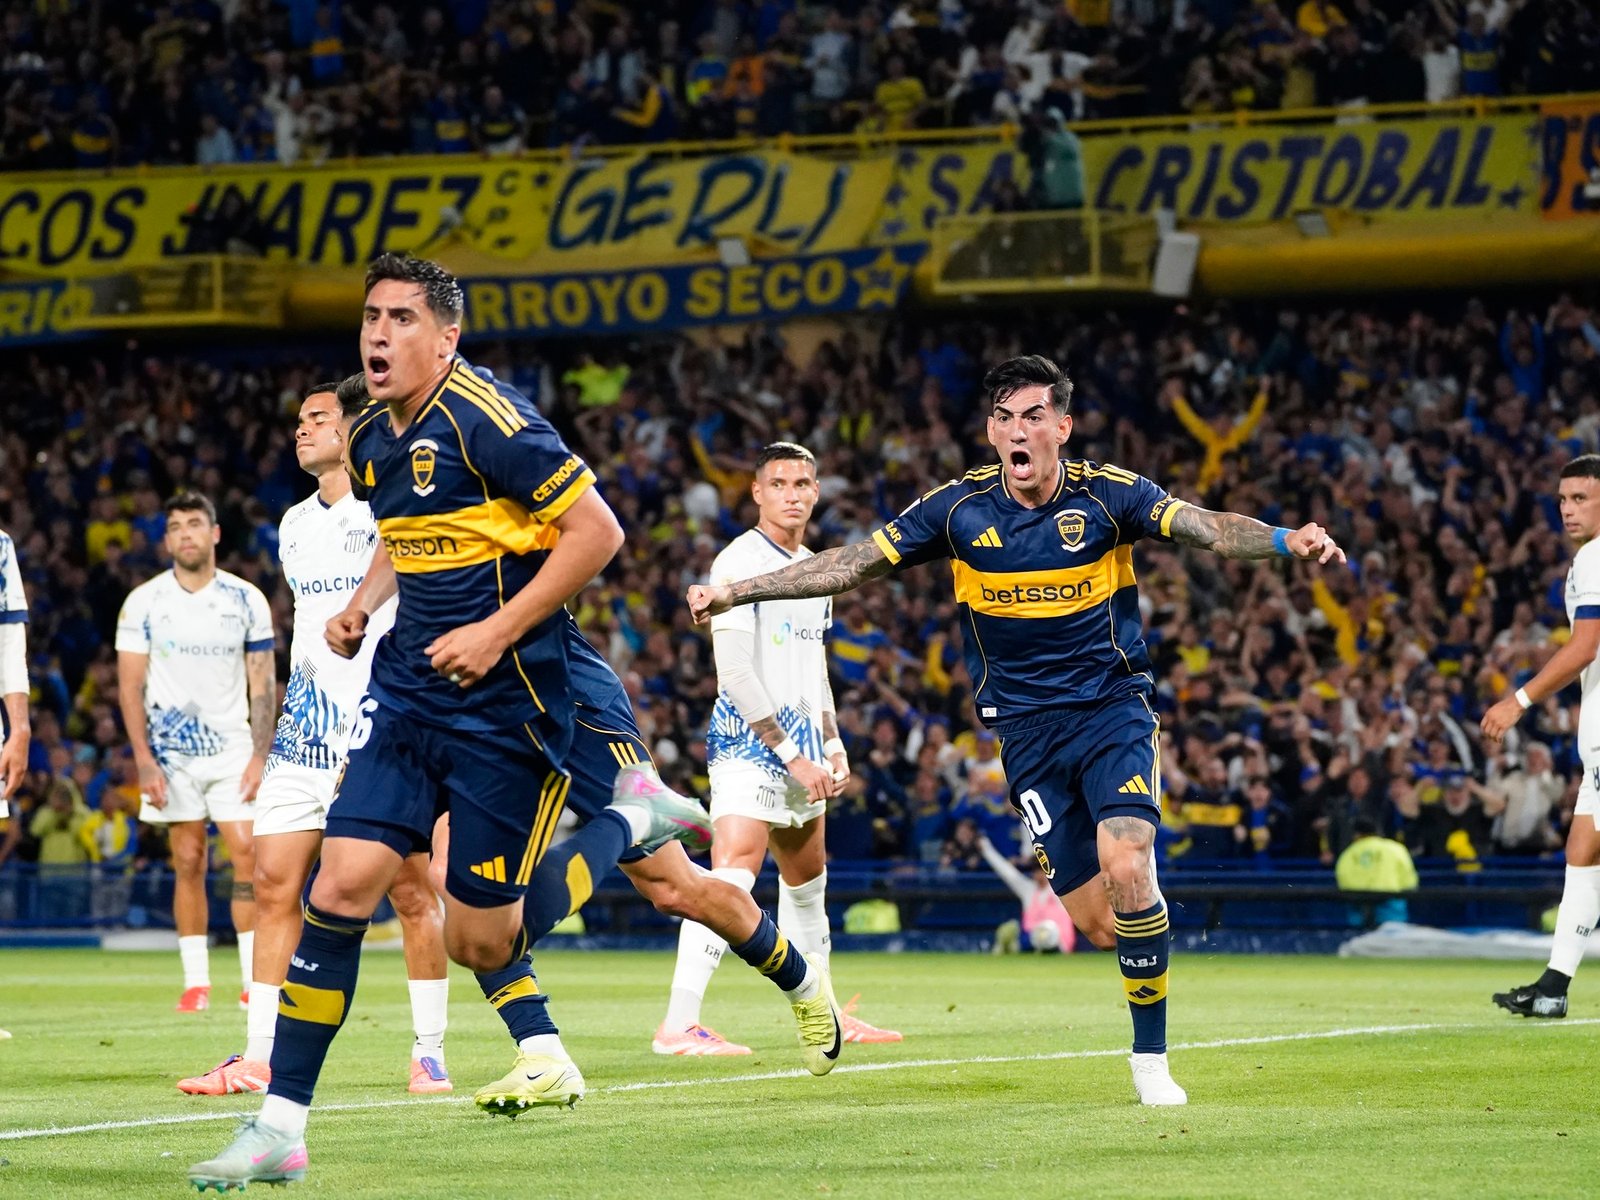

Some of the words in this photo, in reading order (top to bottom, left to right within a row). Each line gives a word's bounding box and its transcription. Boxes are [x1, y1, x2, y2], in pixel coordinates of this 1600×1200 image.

[1095, 126, 1493, 221] CRISTOBAL
[0, 186, 147, 266] COS
[461, 273, 668, 334] RROYO
[685, 258, 846, 317] SECO
[1062, 525, 1082, 533] CABJ
[979, 576, 1092, 603] betsson
[179, 645, 236, 656] HOLCIM
[1020, 788, 1052, 841] 0
[1120, 955, 1158, 968] CABJ
